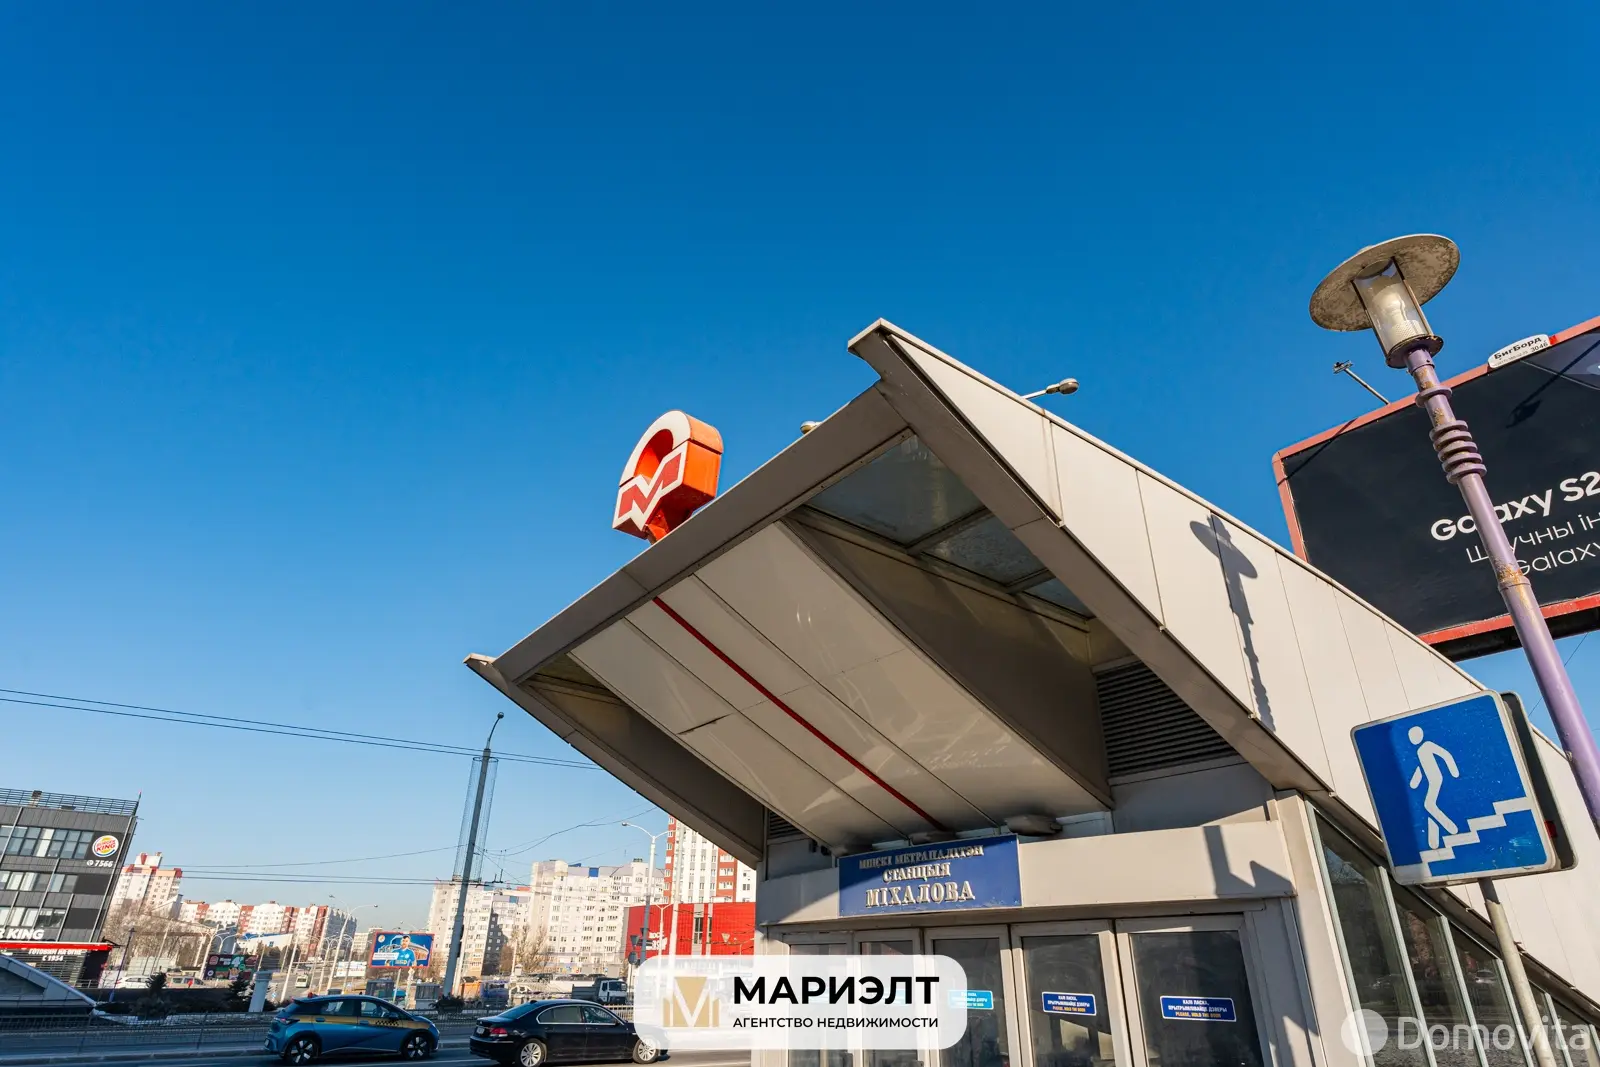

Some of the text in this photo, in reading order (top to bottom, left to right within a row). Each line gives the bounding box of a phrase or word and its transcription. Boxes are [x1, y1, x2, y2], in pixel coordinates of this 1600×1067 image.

[1493, 337, 1542, 360] БигБорд
[1431, 489, 1552, 541] Gaaxy
[1466, 521, 1574, 563] Шучны
[1515, 542, 1600, 577] Galax
[883, 862, 951, 883] СТАНЦЫЯ
[865, 880, 976, 908] МІХАЛОВА
[6, 928, 45, 940] KING
